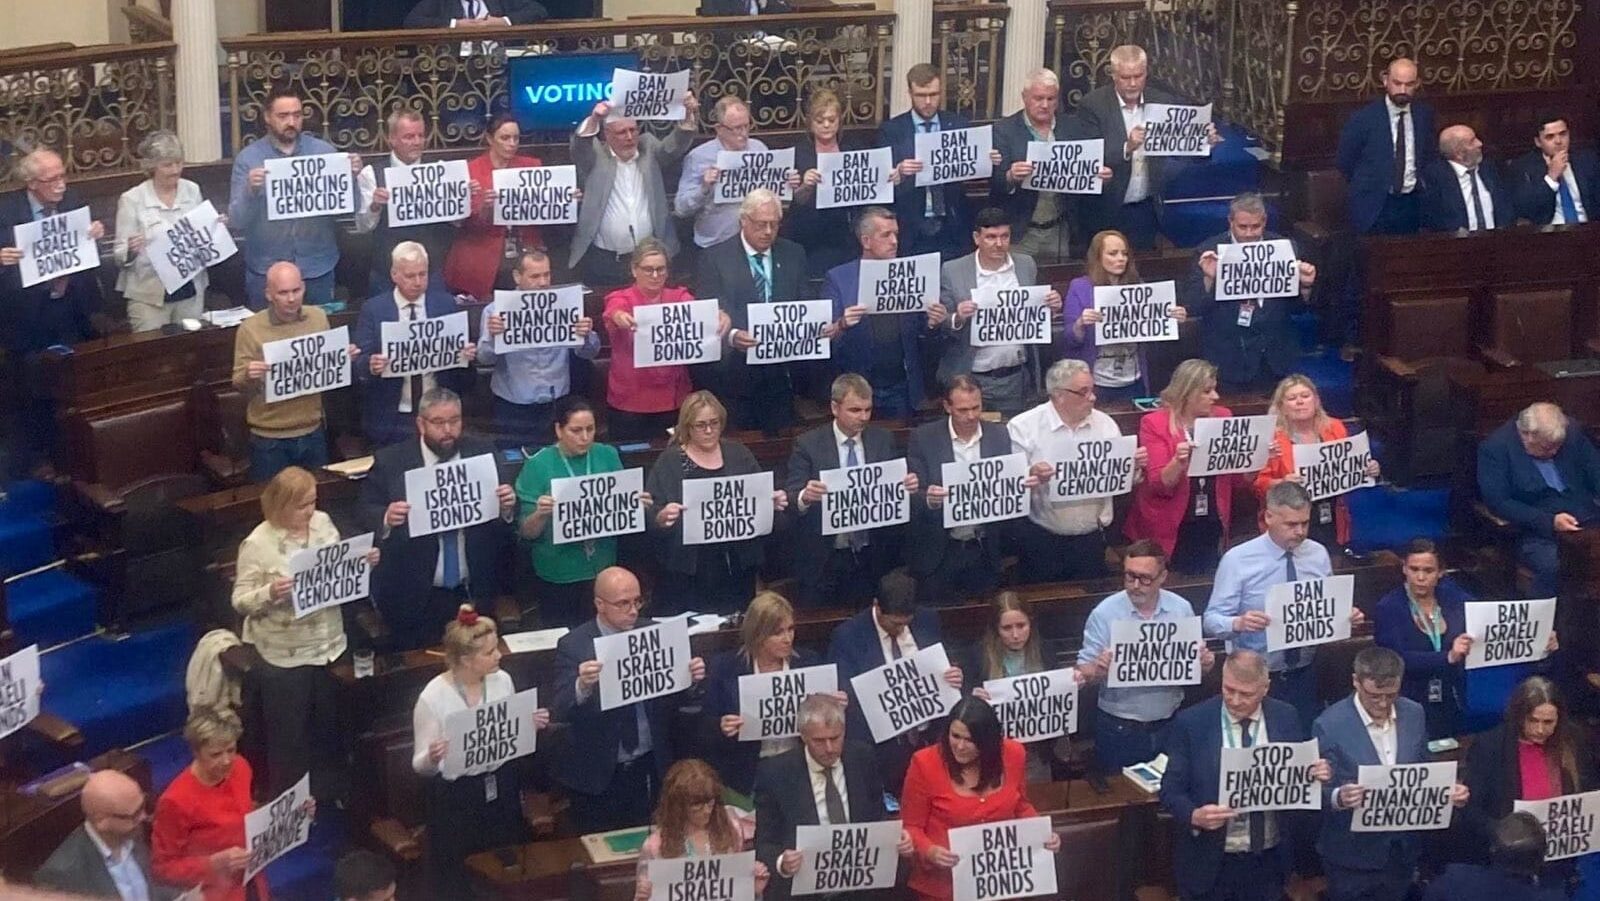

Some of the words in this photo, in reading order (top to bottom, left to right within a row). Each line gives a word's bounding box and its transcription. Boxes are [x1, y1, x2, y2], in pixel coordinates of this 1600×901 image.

[638, 75, 666, 91] BAN
[625, 90, 674, 104] ISRAELI
[624, 102, 669, 117] BONDS
[1167, 107, 1197, 122] STOP
[941, 132, 967, 148] BAN
[1145, 121, 1210, 138] FINANCING
[1051, 144, 1082, 161] STOP
[1144, 135, 1204, 152] GENOCIDE
[741, 153, 774, 169] STOP
[843, 153, 869, 169] BAN
[931, 145, 978, 166] ISRAELI
[291, 158, 325, 175] STOP
[411, 166, 445, 183] STOP
[720, 167, 790, 184] FINANCING
[832, 168, 879, 186] ISRAELI
[933, 162, 976, 180] BONDS
[1032, 159, 1099, 176] FINANCING
[272, 174, 348, 197] FINANCING
[519, 170, 552, 186] STOP
[1030, 175, 1095, 190] GENOCIDE
[276, 192, 345, 213] GENOCIDE
[392, 182, 467, 205] FINANCING
[499, 185, 573, 204] FINANCING
[834, 184, 877, 202] BONDS
[396, 199, 465, 220] GENOCIDE
[502, 203, 570, 220] GENOCIDE
[41, 214, 67, 238] BAN
[167, 218, 194, 247] BAN
[32, 230, 78, 259] ISRAELI
[166, 226, 212, 266] ISRAELI
[1242, 244, 1275, 262] STOP
[38, 248, 81, 276] BONDS
[177, 243, 220, 280] BONDS
[888, 260, 915, 279] BAN
[1221, 260, 1295, 279] FINANCING
[875, 276, 926, 296] ISRAELI
[1120, 286, 1153, 303] STOP
[1224, 277, 1292, 295] GENOCIDE
[521, 291, 557, 308] STOP
[876, 292, 924, 311] BONDS
[997, 289, 1029, 306] STOP
[500, 307, 580, 326] FINANCING
[661, 305, 691, 322] BAN
[774, 304, 807, 323] STOP
[977, 307, 1046, 325] FINANCING
[409, 322, 444, 340] STOP
[503, 325, 577, 344] GENOCIDE
[651, 321, 703, 343] ISRAELI
[978, 323, 1043, 341] GENOCIDE
[1102, 319, 1170, 338] GENOCIDE
[291, 337, 325, 356] STOP
[387, 333, 464, 356] FINANCING
[654, 339, 702, 361] BONDS
[755, 337, 822, 359] GENOCIDE
[271, 352, 346, 377] FINANCING
[390, 350, 461, 373] GENOCIDE
[274, 369, 343, 395] GENOCIDE
[1222, 419, 1250, 437] BAN
[1078, 441, 1112, 460] STOP
[1208, 435, 1258, 455] ISRAELI
[1319, 441, 1353, 463] STOP
[968, 461, 1003, 481] STOP
[1055, 457, 1131, 480] FINANCING
[1207, 452, 1252, 471] BONDS
[435, 466, 467, 486] BAN
[847, 467, 882, 487] STOP
[1058, 475, 1127, 496] GENOCIDE
[425, 481, 481, 509] ISRAELI
[579, 477, 616, 498] STOP
[713, 480, 744, 499] BAN
[827, 482, 904, 509] FINANCING
[948, 477, 1025, 502] FINANCING
[430, 502, 481, 529] BONDS
[558, 494, 639, 519] FINANCING
[701, 498, 756, 520] ISRAELI
[830, 501, 902, 528] GENOCIDE
[952, 495, 1023, 521] GENOCIDE
[562, 512, 637, 538] GENOCIDE
[704, 518, 755, 540] BONDS
[315, 543, 349, 566] STOP
[293, 558, 365, 592] FINANCING
[297, 577, 363, 610] GENOCIDE
[1294, 580, 1323, 600] BAN
[1283, 598, 1335, 619] ISRAELI
[1498, 603, 1528, 623] BAN
[1140, 623, 1177, 642] STOP
[1285, 616, 1334, 643] BONDS
[1484, 621, 1538, 642] ISRAELI
[628, 630, 660, 654] BAN
[1114, 640, 1198, 662] FINANCING
[1484, 642, 1533, 661] BONDS
[617, 648, 674, 679] ISRAELI
[884, 660, 920, 687] BAN
[1117, 660, 1193, 681] GENOCIDE
[621, 668, 674, 700] BONDS
[772, 673, 805, 697] BAN
[879, 675, 939, 712] ISRAELI
[1013, 675, 1050, 701] STOP
[476, 702, 507, 727] BAN
[759, 694, 805, 719] ISRA
[890, 694, 944, 730] BONDS
[463, 717, 519, 749] ISRAELI
[761, 716, 799, 736] BON
[465, 738, 517, 767] BONDS
[1252, 747, 1293, 767] STOP
[1227, 765, 1316, 790] FINANCING
[1389, 768, 1429, 788] STOP
[1229, 785, 1311, 808] GENOCIDE
[1362, 787, 1449, 808] FINANCING
[1362, 806, 1443, 826] GENOCIDE
[1548, 797, 1582, 820] BAN
[1540, 813, 1594, 838] RAELI
[832, 829, 868, 848] BAN
[983, 825, 1018, 851] BAN
[1547, 833, 1590, 857] ONDS
[815, 848, 879, 869] ISRAELI
[972, 847, 1033, 876] ISRAELI
[683, 860, 720, 880] BAN
[816, 867, 874, 889] BONDS
[669, 878, 733, 901] ISRAELI
[977, 870, 1034, 898] BONDS
